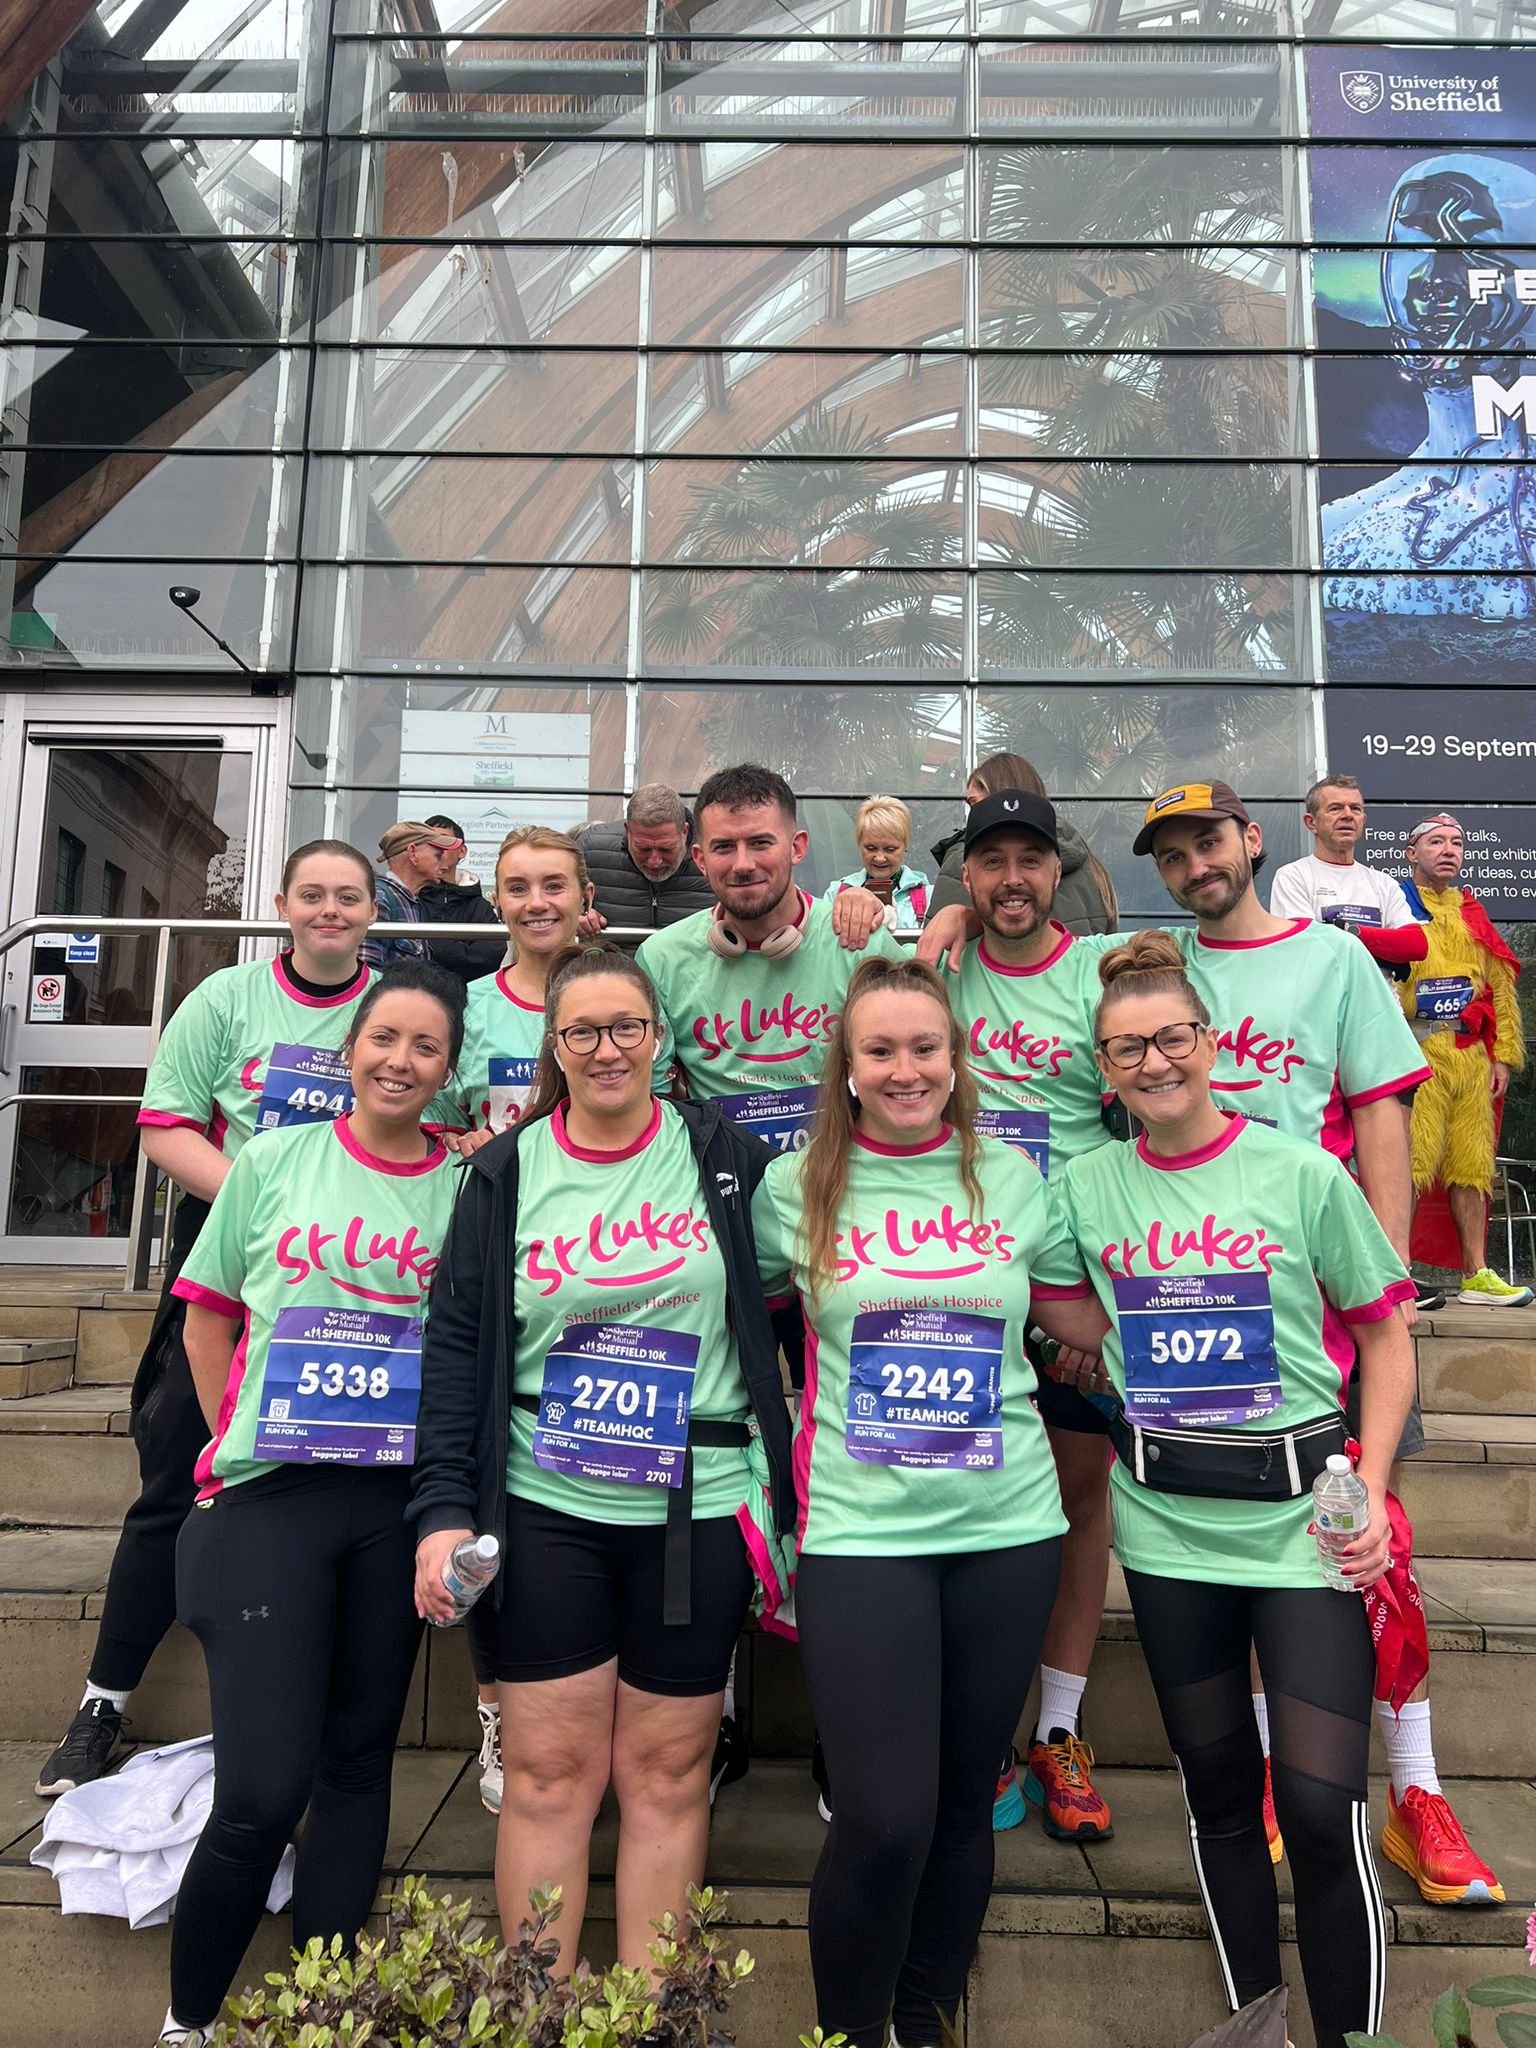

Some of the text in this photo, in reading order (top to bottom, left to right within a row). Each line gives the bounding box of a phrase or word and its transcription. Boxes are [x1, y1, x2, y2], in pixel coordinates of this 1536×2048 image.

[1388, 75, 1500, 92] University of
[1390, 92, 1503, 112] Sheffield
[486, 715, 507, 734] M
[1362, 735, 1436, 756] 19–29
[475, 761, 512, 770] Sheffield
[1365, 828, 1395, 841] Free
[1466, 829, 1501, 843] talks,
[1464, 849, 1489, 860] and
[1459, 867, 1474, 878] of
[1478, 867, 1517, 880] ideas,
[1503, 886, 1517, 897] to
[70, 949, 82, 957] Keep
[740, 992, 840, 1043] Luke's
[748, 1103, 805, 1118] SHEFFIELD 10K
[1006, 1127, 1021, 1135] 10K
[589, 1201, 711, 1263] Luke's
[885, 1205, 1016, 1261] Luke's
[1146, 1214, 1283, 1277] Luke's
[343, 1215, 442, 1291] Luke
[1174, 1287, 1201, 1295] Mutual
[858, 1295, 1003, 1313] Sheffield's Hospice
[1160, 1294, 1236, 1307] SHEFFIELD 10K
[564, 1292, 701, 1325] Sheffield's Hospice
[339, 1311, 370, 1323] Sheffield
[915, 1313, 947, 1323] Sheffield
[339, 1321, 365, 1330] Mutual
[915, 1321, 943, 1330] Mutual
[322, 1328, 391, 1345] SHEFFIELD 10K
[612, 1336, 638, 1346] Mutual
[900, 1329, 973, 1344] SHEFFIELD 10K
[596, 1342, 667, 1361] SHEFFIELD 10K
[1151, 1327, 1244, 1364] 5072
[296, 1361, 390, 1399] 5338
[881, 1363, 974, 1403] 2242
[570, 1374, 658, 1418] 2701
[886, 1407, 969, 1425] #TEAMHQC
[1179, 1417, 1209, 1425] Baggage
[573, 1417, 655, 1440] #TEAMHQC
[854, 1429, 869, 1437] RUN
[870, 1430, 884, 1438] FOR
[541, 1438, 580, 1450] RUN FOR ALL
[311, 1451, 342, 1459] Baggage
[375, 1449, 403, 1461] 5338
[901, 1455, 948, 1464] Baggage label
[965, 1454, 994, 1465] 2242
[582, 1466, 611, 1478] Baggage
[612, 1470, 629, 1479] label
[646, 1470, 672, 1483] 2701
